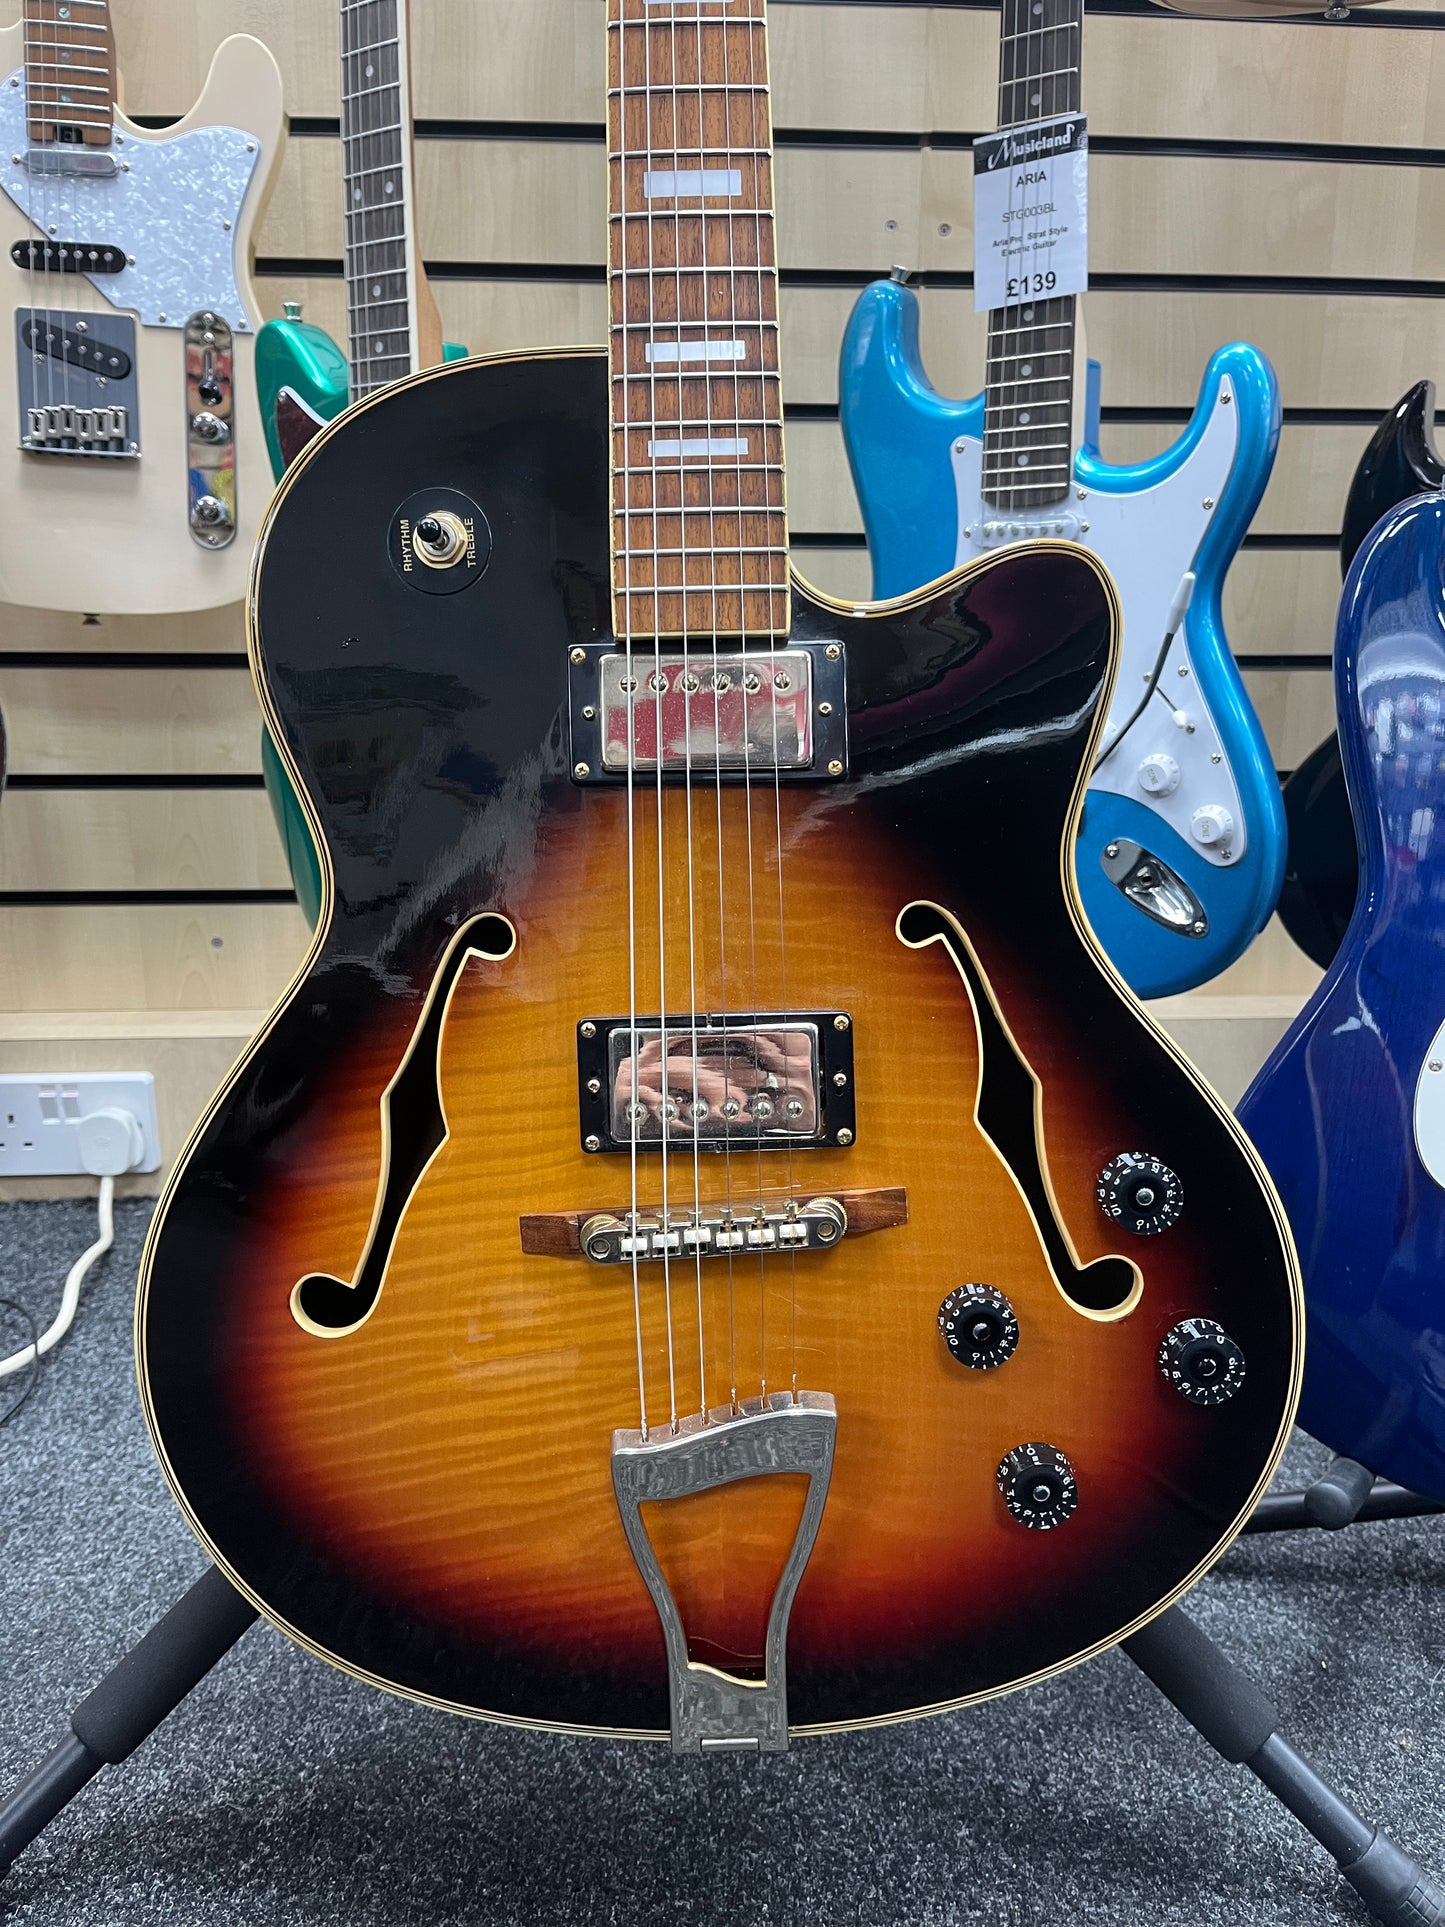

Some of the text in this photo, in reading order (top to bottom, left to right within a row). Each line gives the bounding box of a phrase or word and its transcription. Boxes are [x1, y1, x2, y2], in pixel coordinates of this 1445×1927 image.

[988, 123, 1075, 169] Musicland
[1016, 171, 1047, 188] ARIA
[1048, 226, 1069, 236] Style
[1032, 240, 1057, 250] Guitar
[1006, 271, 1057, 297] £139
[400, 519, 413, 572] RHYTHM
[464, 517, 477, 569] TREBLE
